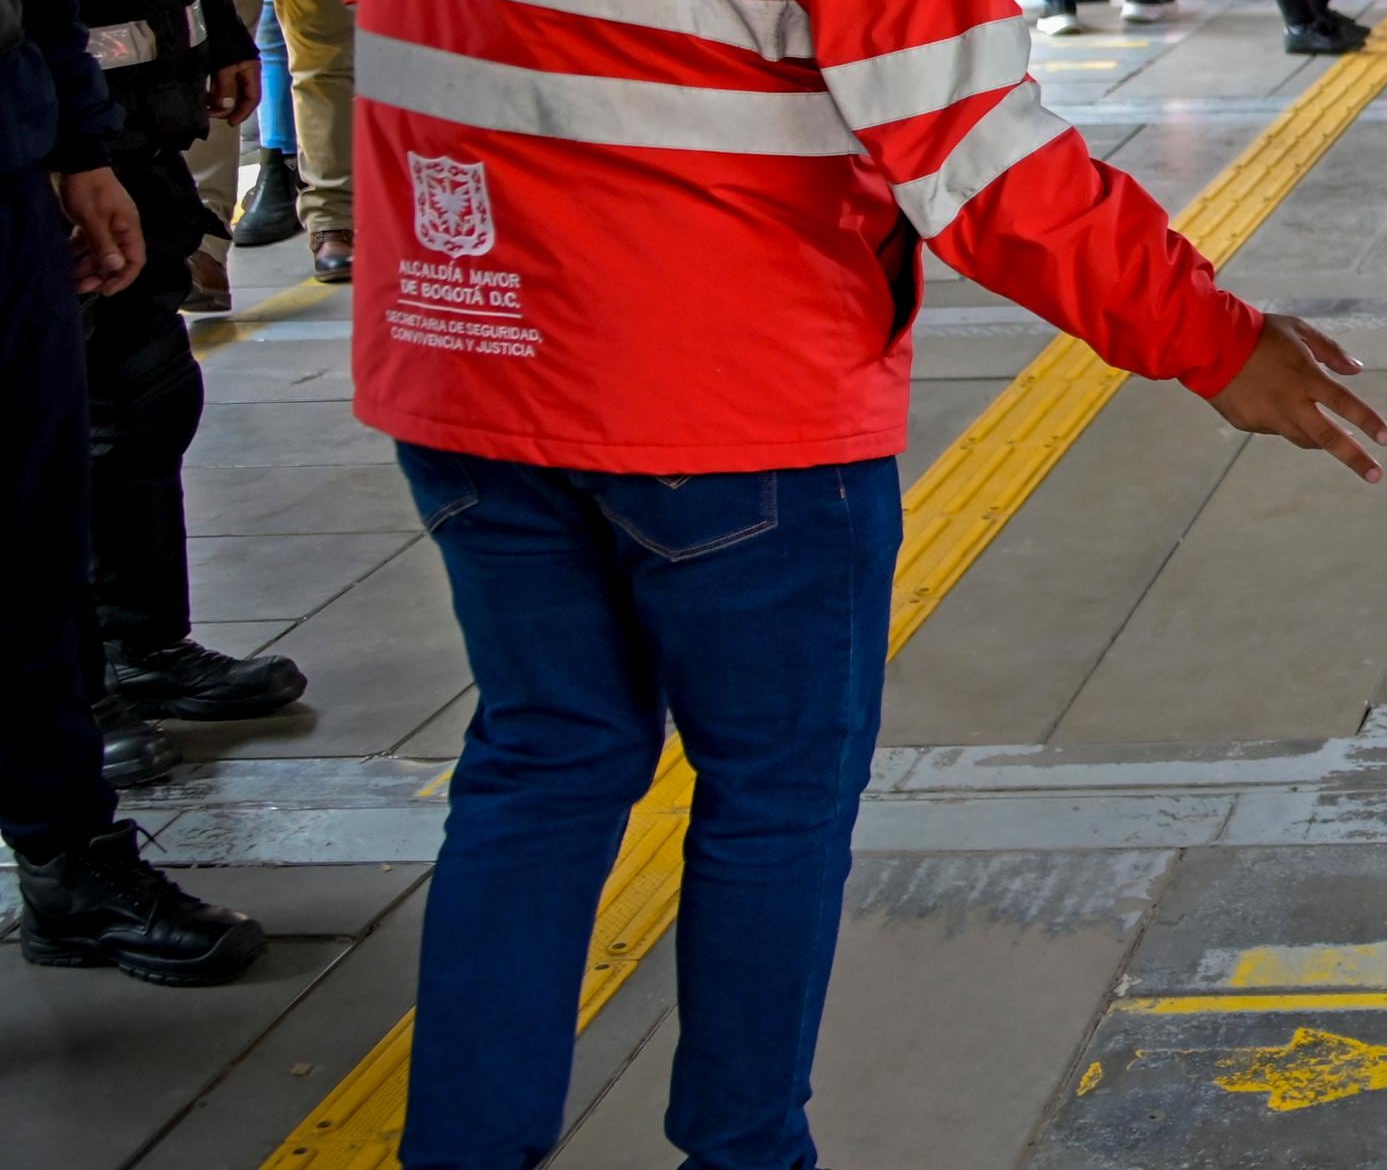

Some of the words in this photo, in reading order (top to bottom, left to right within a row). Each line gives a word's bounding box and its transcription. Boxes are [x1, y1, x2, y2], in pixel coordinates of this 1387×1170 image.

[469, 269, 521, 288] MAYOR
[400, 279, 418, 295] DE
[421, 282, 484, 306] BOGOTÁ
[489, 291, 522, 309] D.C.
[449, 320, 465, 334] DE
[465, 338, 475, 351] Y
[476, 341, 536, 358] JUSTICIA
